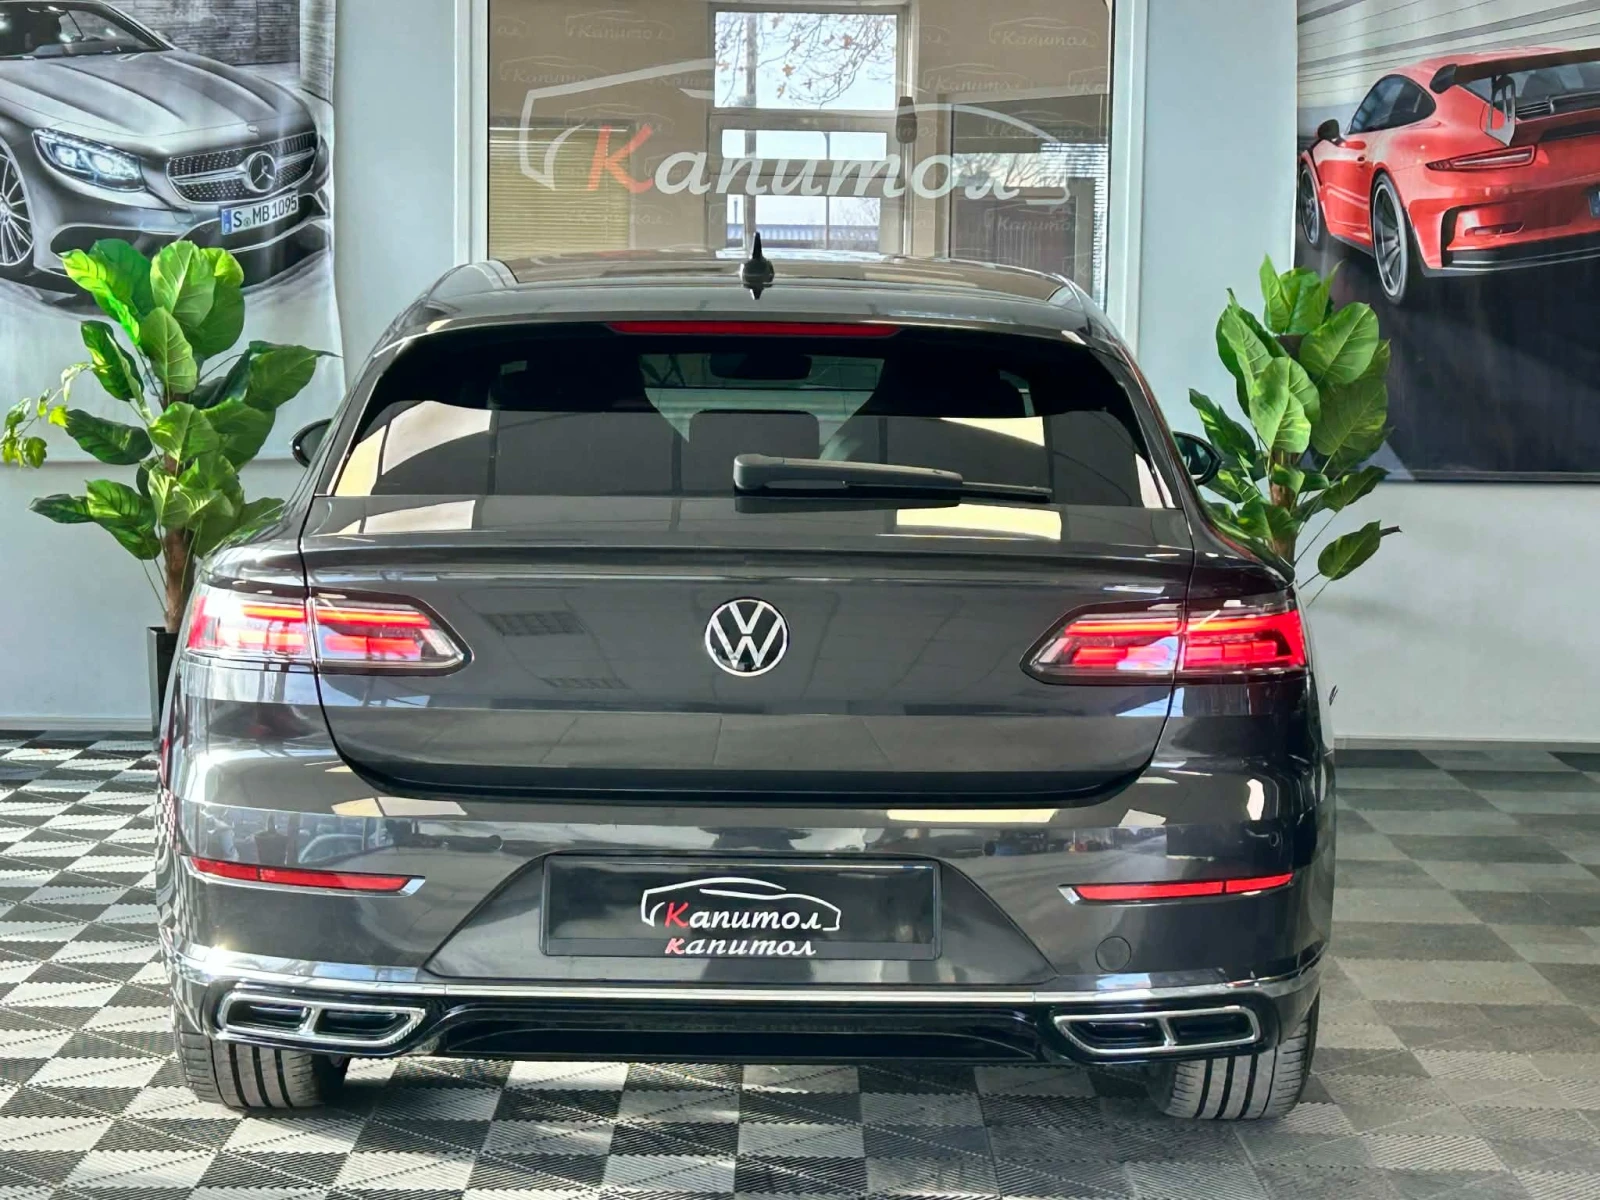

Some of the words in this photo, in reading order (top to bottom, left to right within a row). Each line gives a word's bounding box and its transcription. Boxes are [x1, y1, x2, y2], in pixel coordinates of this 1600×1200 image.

[588, 123, 1021, 200] Капитол
[233, 211, 243, 228] S
[252, 205, 270, 225] MB
[272, 195, 298, 219] 1095
[664, 902, 822, 929] Капитол
